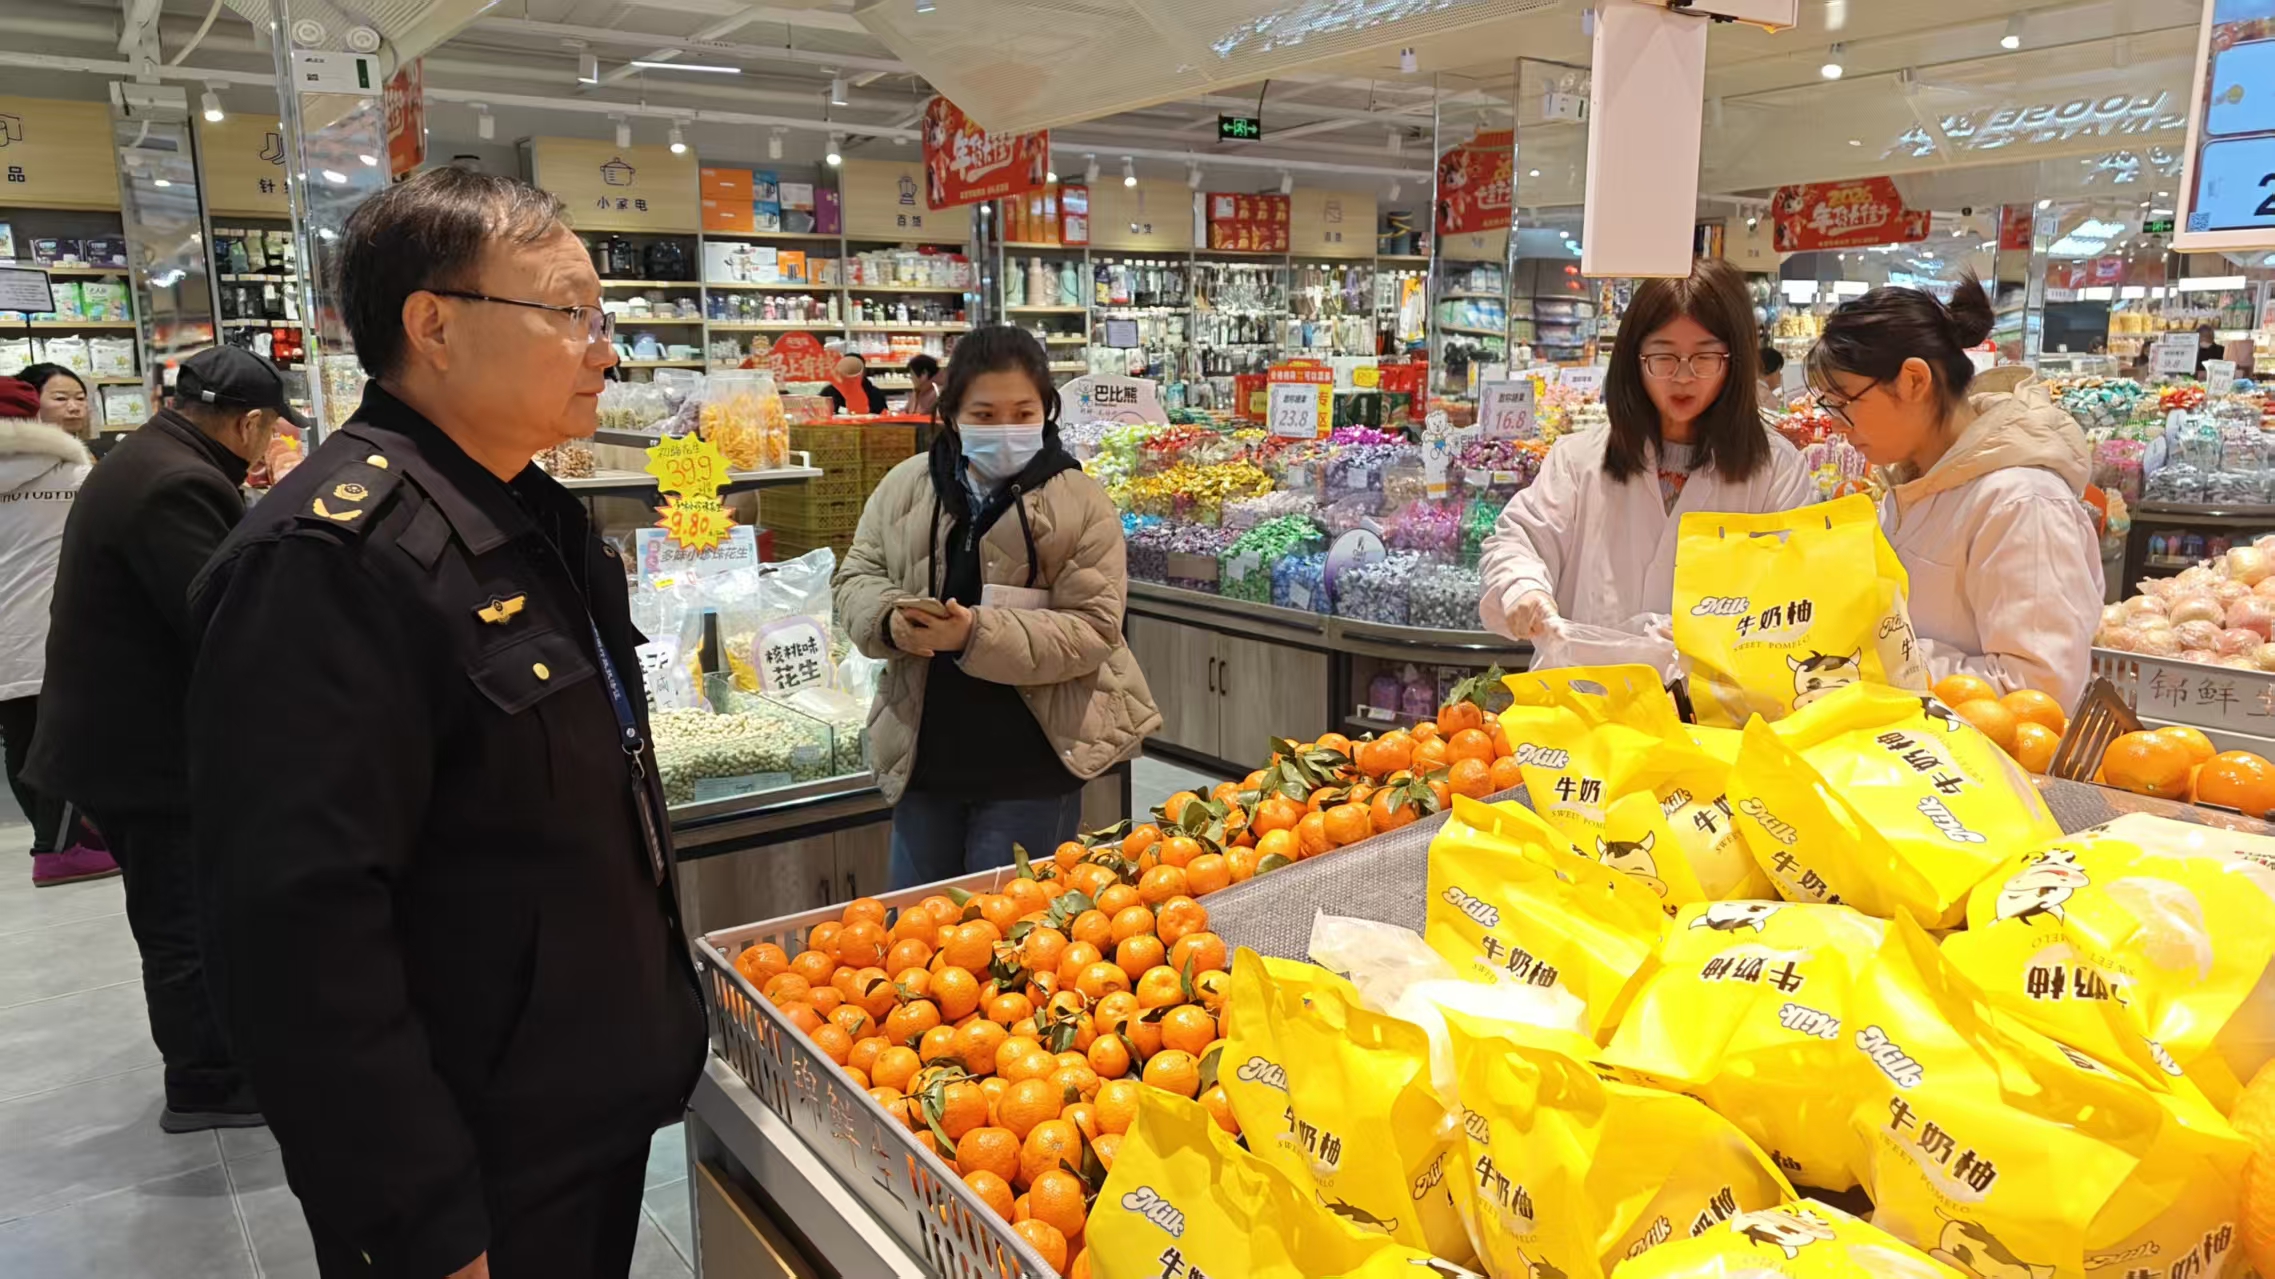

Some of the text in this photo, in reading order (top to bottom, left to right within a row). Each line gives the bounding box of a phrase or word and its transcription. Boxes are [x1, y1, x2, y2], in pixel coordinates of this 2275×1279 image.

[597, 195, 648, 212] 小家电
[1095, 384, 1137, 404] 巴比熊
[1279, 409, 1309, 428] 23.8
[1496, 410, 1526, 431] 16.8
[1691, 596, 1750, 616] Milk
[1736, 599, 1812, 637] 牛奶柚
[765, 636, 819, 664] 核桃味
[774, 659, 821, 690] 花生
[1515, 743, 1569, 769] Milk
[1876, 731, 1964, 794] 牛奶柚
[1554, 777, 1606, 803] 牛奶
[1442, 886, 1500, 928] Milk
[1482, 936, 1560, 988] 牛奶柚
[1701, 957, 1804, 993] 牛奶柚
[1855, 1025, 1924, 1088] Milk
[1890, 1096, 1997, 1193] 牛奶柚
[1121, 1186, 1184, 1237] Milk
